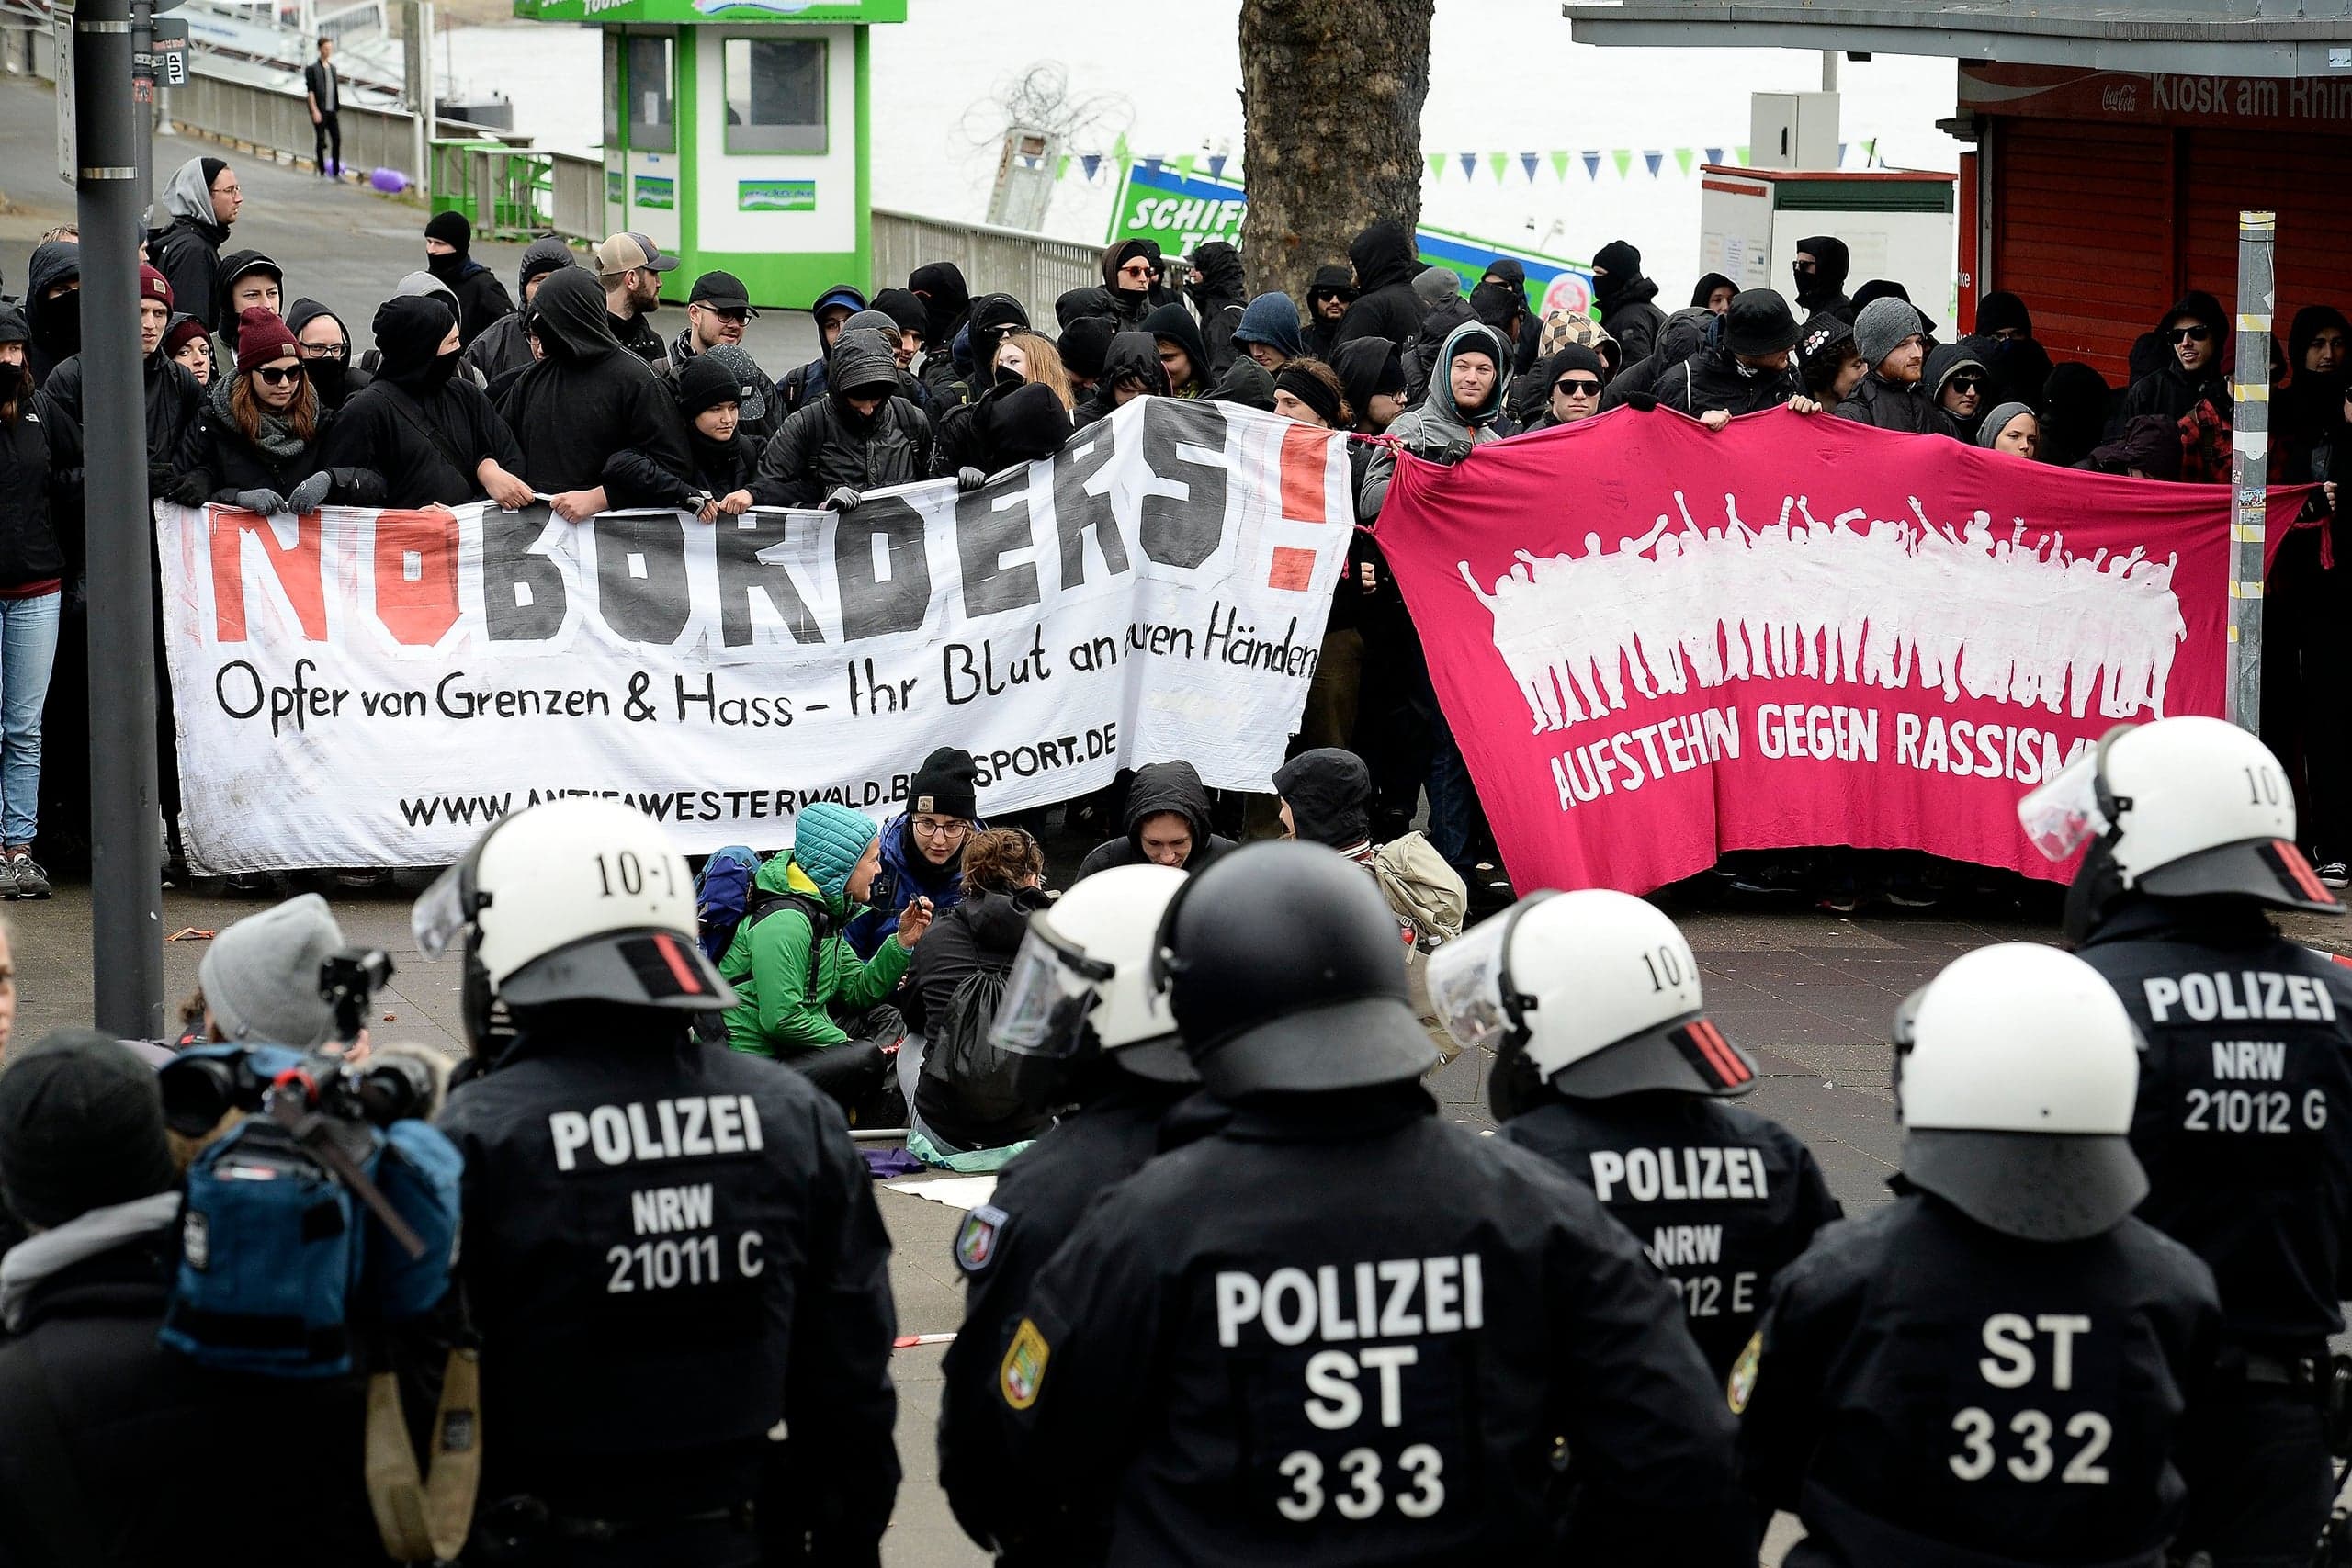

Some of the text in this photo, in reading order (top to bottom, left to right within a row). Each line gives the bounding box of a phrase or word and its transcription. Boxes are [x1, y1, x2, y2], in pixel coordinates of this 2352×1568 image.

[168, 55, 182, 82] 1UP
[2236, 77, 2278, 116] am
[1127, 197, 1248, 231] SCHIF
[216, 659, 349, 738] Opfer
[361, 690, 426, 717] von
[436, 671, 609, 718] Grenzen
[623, 671, 657, 722] &
[675, 672, 793, 727] Hass
[848, 658, 918, 716] Ihr
[944, 623, 1052, 705] Blut
[1069, 637, 1117, 672] an
[1204, 600, 1318, 679] Händen
[1550, 703, 2097, 812] AUFSTEHN GEGEN RASSISM
[2143, 970, 2337, 1022] POLIZEI
[2211, 1041, 2287, 1081] NRW
[548, 1094, 765, 1172] POLIZEI
[2183, 1088, 2328, 1134] 21012 G
[1589, 1146, 1770, 1202] POLIZEI
[631, 1182, 714, 1236] NRW
[605, 1229, 765, 1294] 21011 C
[1653, 1224, 1724, 1267] NRW
[1215, 1252, 1485, 1348] POLIZEI
[1732, 1271, 1758, 1314] E
[1978, 1312, 2093, 1392] ST
[1303, 1344, 1419, 1431] ST
[1947, 1405, 2114, 1485] 332
[1275, 1442, 1447, 1523] 333
